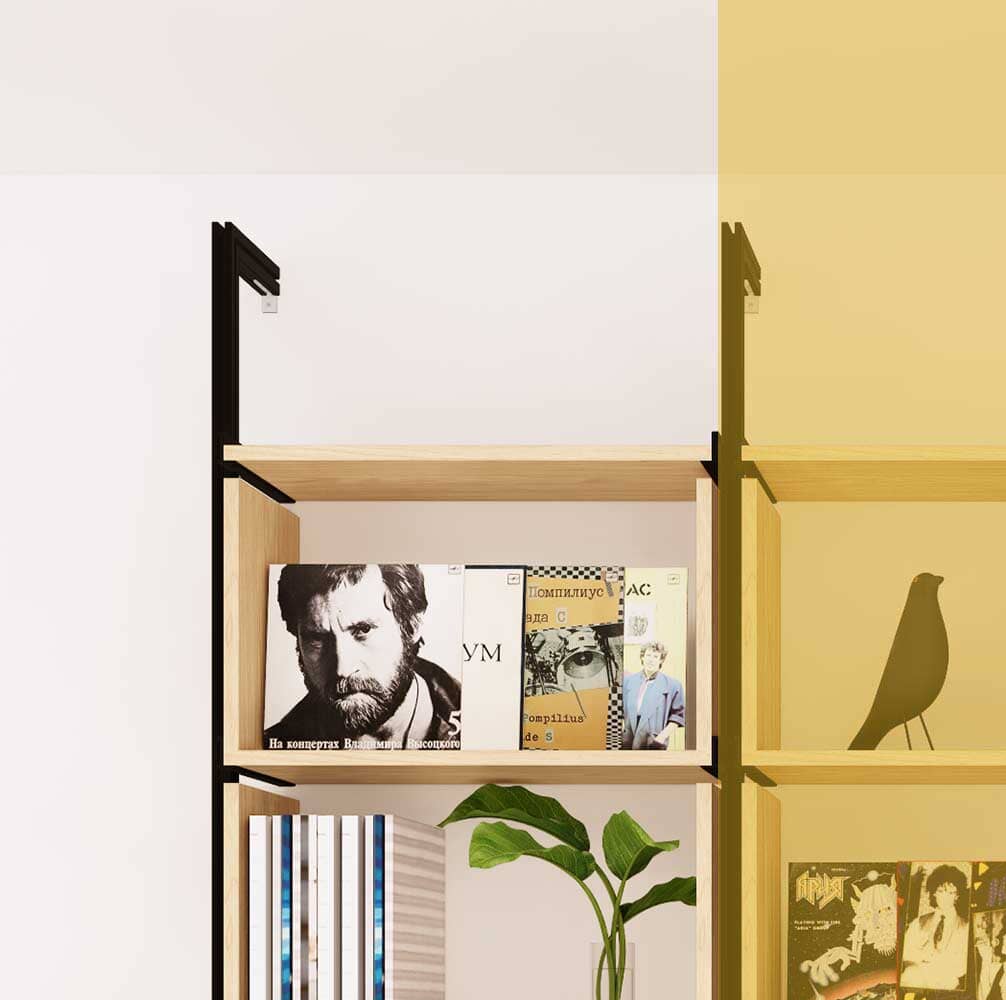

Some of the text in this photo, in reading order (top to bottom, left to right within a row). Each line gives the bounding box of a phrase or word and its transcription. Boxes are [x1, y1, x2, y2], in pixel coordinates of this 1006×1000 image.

[528, 584, 604, 600] Помпилиус
[463, 643, 501, 662] УМ
[448, 711, 461, 736] 5
[269, 738, 460, 750] На концертах Владимира Высоцкого
[525, 732, 553, 742] de S
